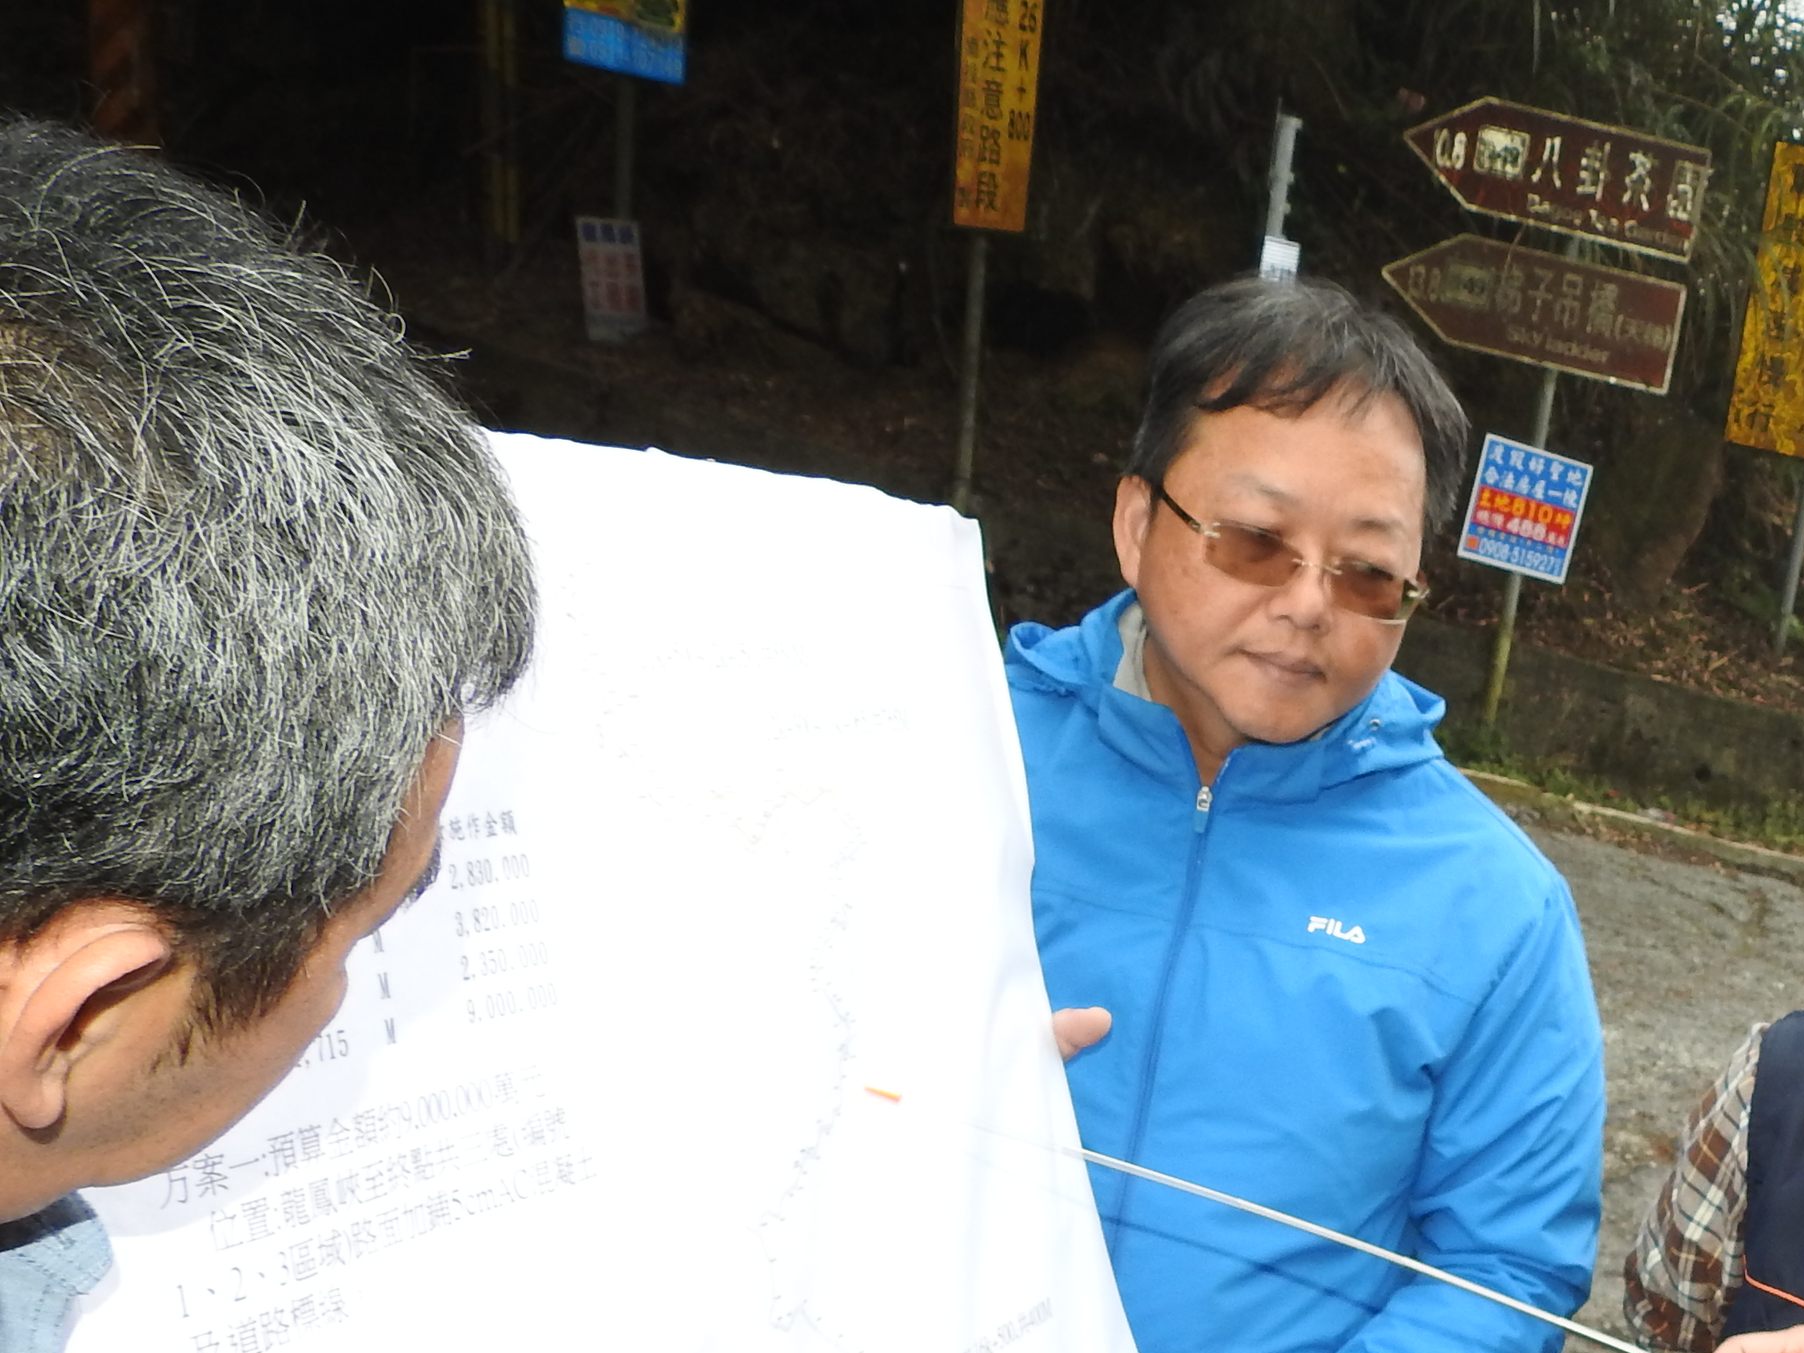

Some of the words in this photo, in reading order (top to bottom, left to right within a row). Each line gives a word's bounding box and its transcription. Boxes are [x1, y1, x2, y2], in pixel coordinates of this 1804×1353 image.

[1307, 915, 1366, 944] FILA
[377, 972, 392, 1000] M
[295, 1029, 351, 1068] ,715
[383, 1016, 398, 1045] M
